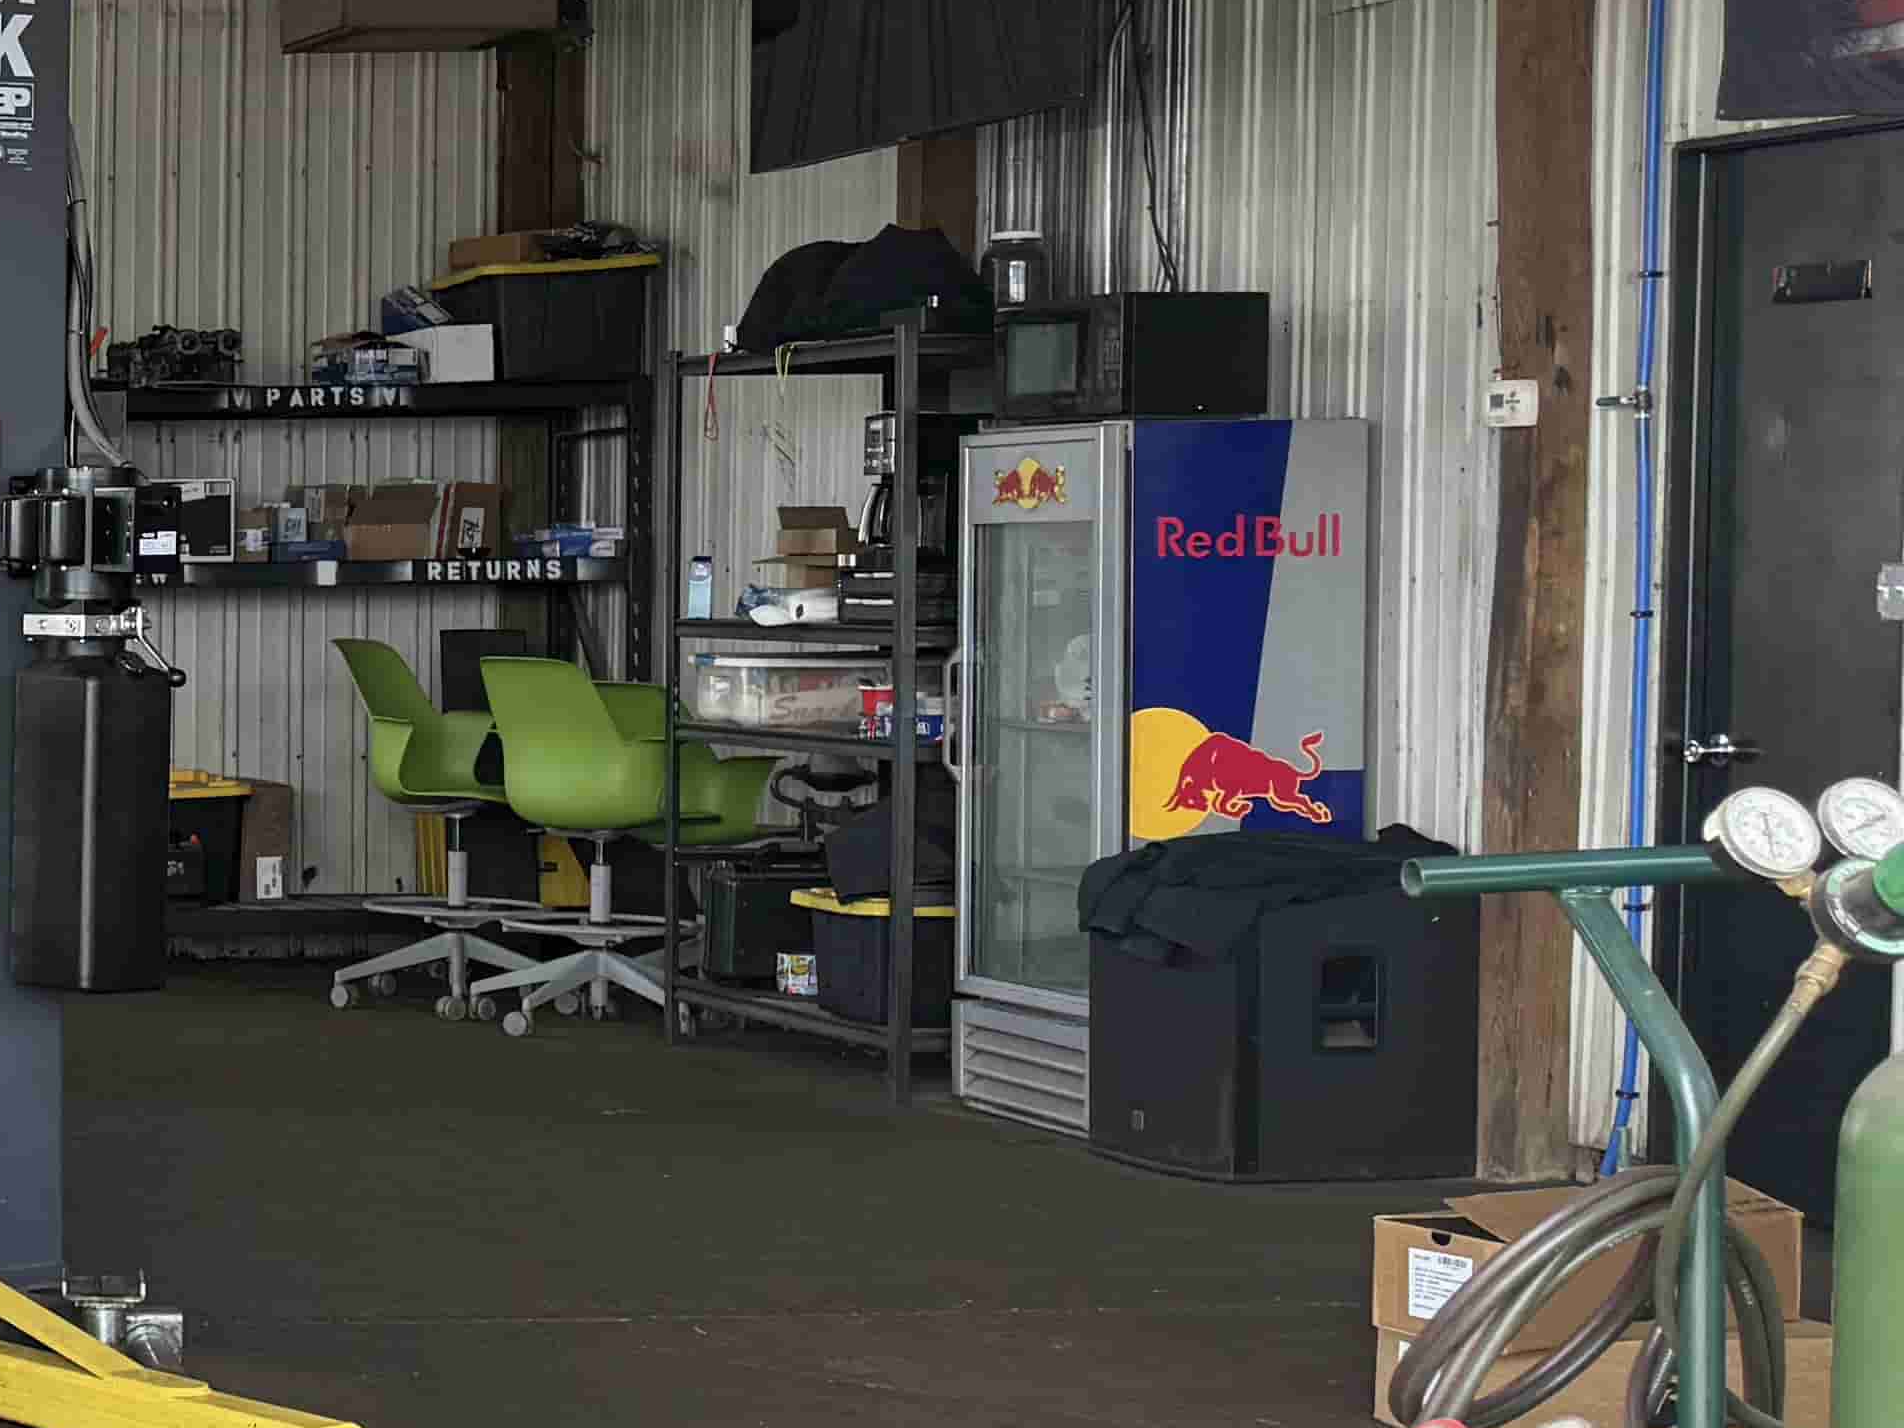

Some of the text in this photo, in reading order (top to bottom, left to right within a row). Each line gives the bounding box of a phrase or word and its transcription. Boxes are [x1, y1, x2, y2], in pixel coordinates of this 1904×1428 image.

[265, 386, 365, 408] PARTS
[1155, 514, 1342, 558] Red Bull
[426, 559, 563, 582] RETURNS
